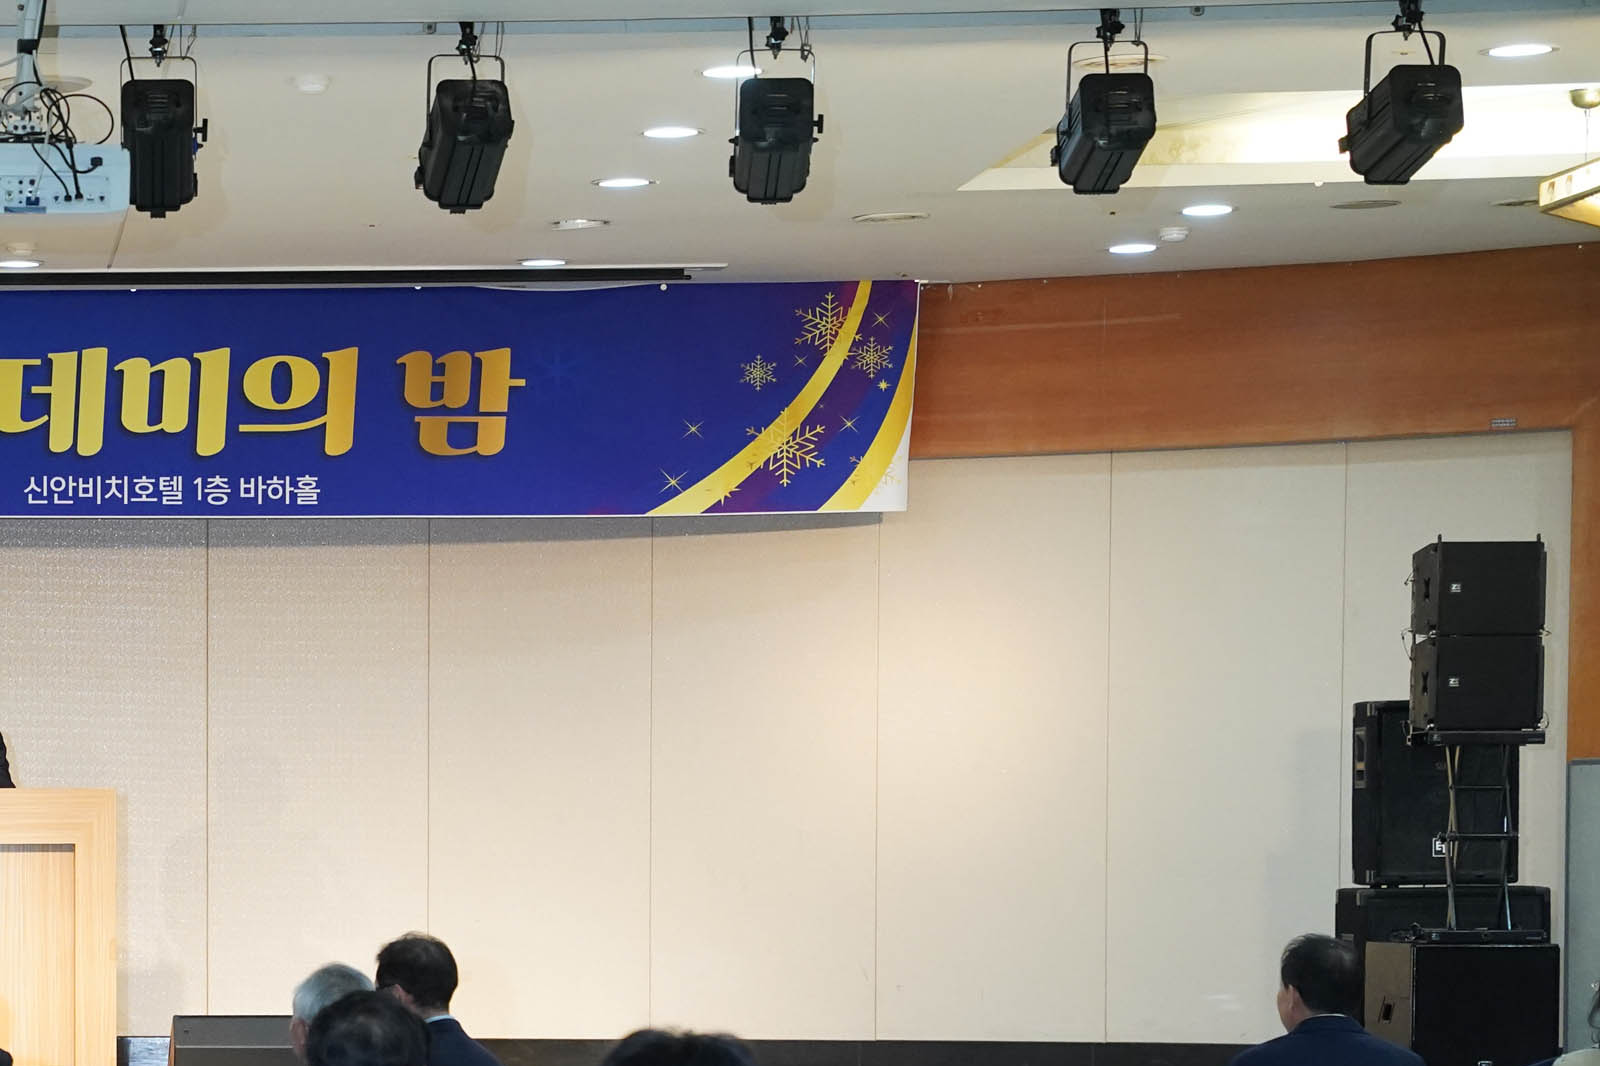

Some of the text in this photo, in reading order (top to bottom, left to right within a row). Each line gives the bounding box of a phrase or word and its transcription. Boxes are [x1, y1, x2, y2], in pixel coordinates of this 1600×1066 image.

[395, 346, 527, 457] 밤
[23, 475, 184, 505] 신안비치호텔
[193, 475, 232, 506] 1층
[240, 475, 321, 505] 바하홀
